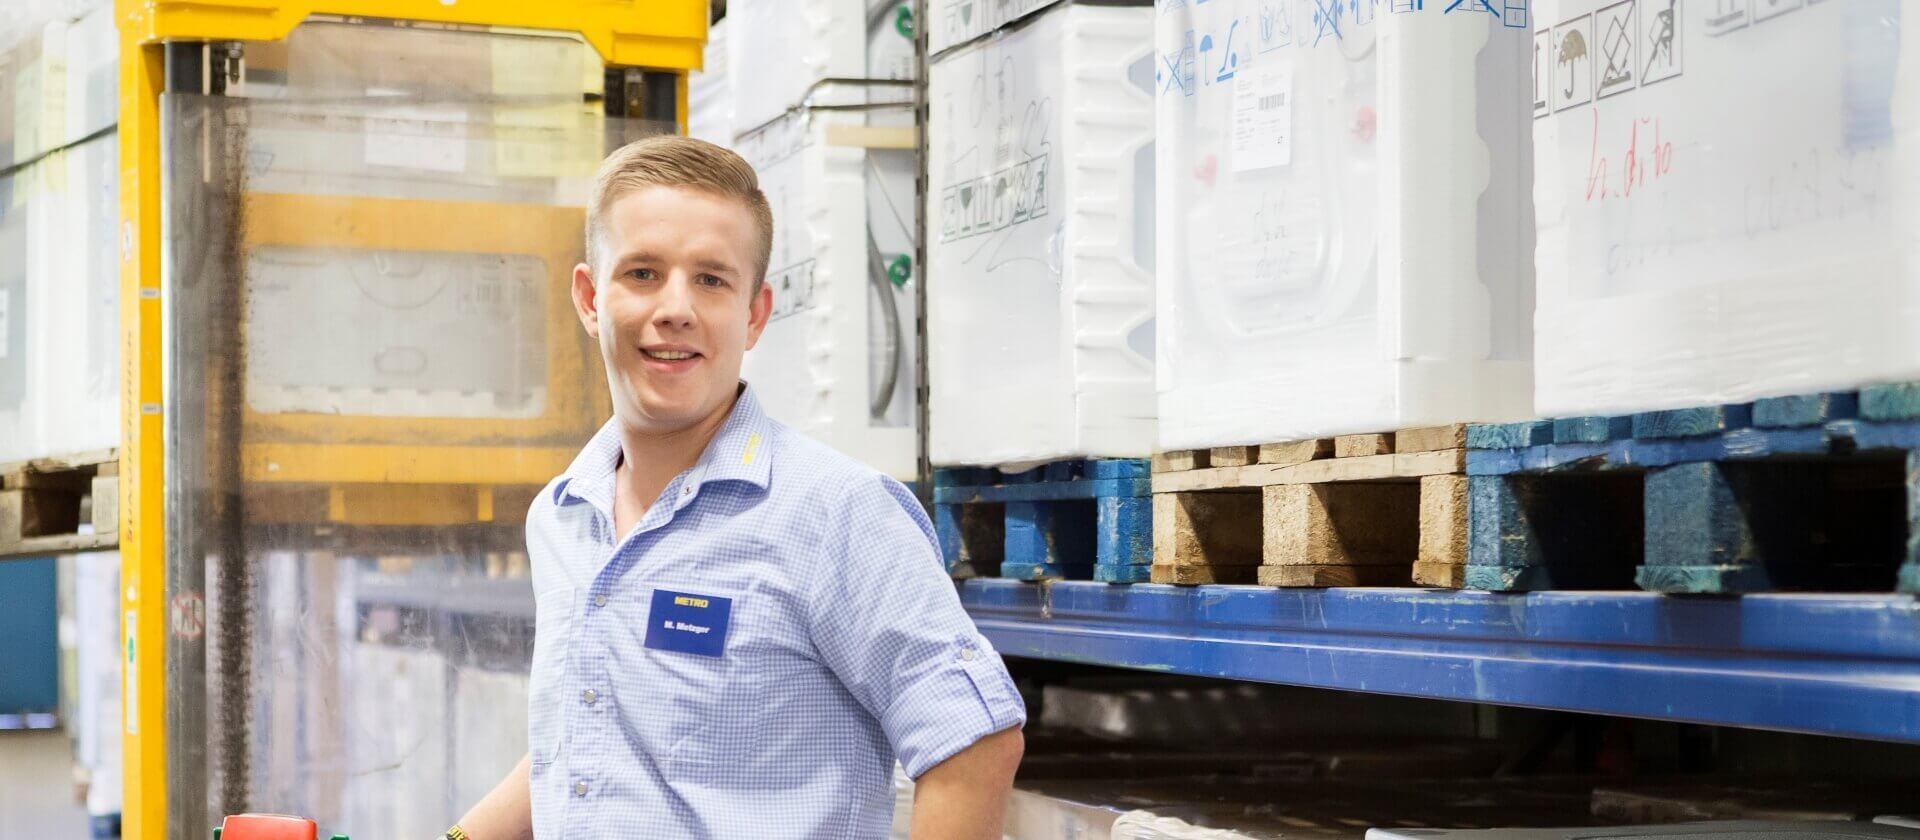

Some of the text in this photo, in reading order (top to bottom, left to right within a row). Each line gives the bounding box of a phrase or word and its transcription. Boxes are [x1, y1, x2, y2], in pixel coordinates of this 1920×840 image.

[674, 596, 709, 608] METRO
[663, 620, 711, 634] M. Metzger
